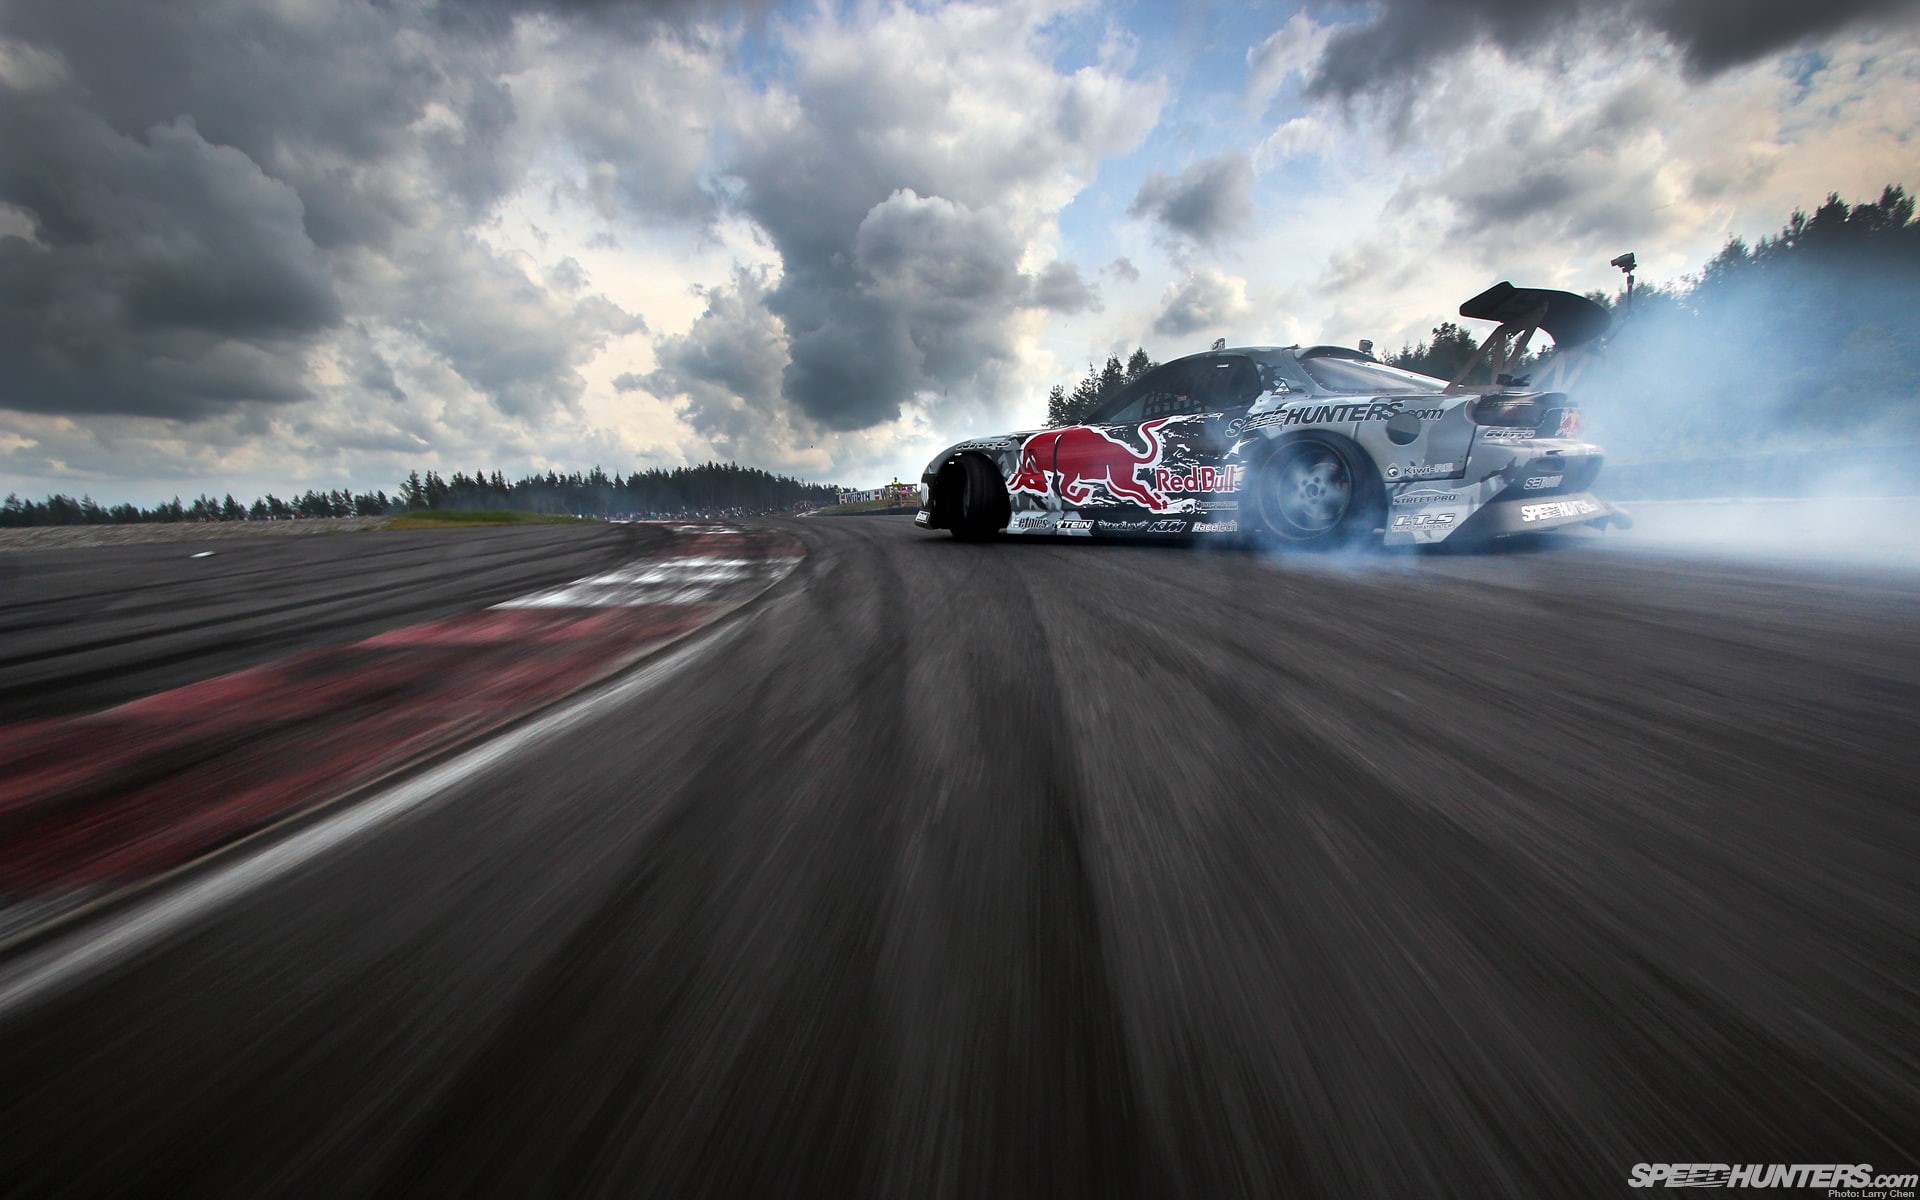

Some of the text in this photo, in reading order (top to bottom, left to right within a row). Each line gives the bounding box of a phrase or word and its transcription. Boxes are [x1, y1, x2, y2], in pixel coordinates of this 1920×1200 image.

[1155, 464, 1237, 493] Red Bull
[1020, 517, 1048, 530] etnies
[1063, 520, 1092, 530] TEIN
[1147, 520, 1187, 533] KTM
[1192, 520, 1238, 533] Racetech
